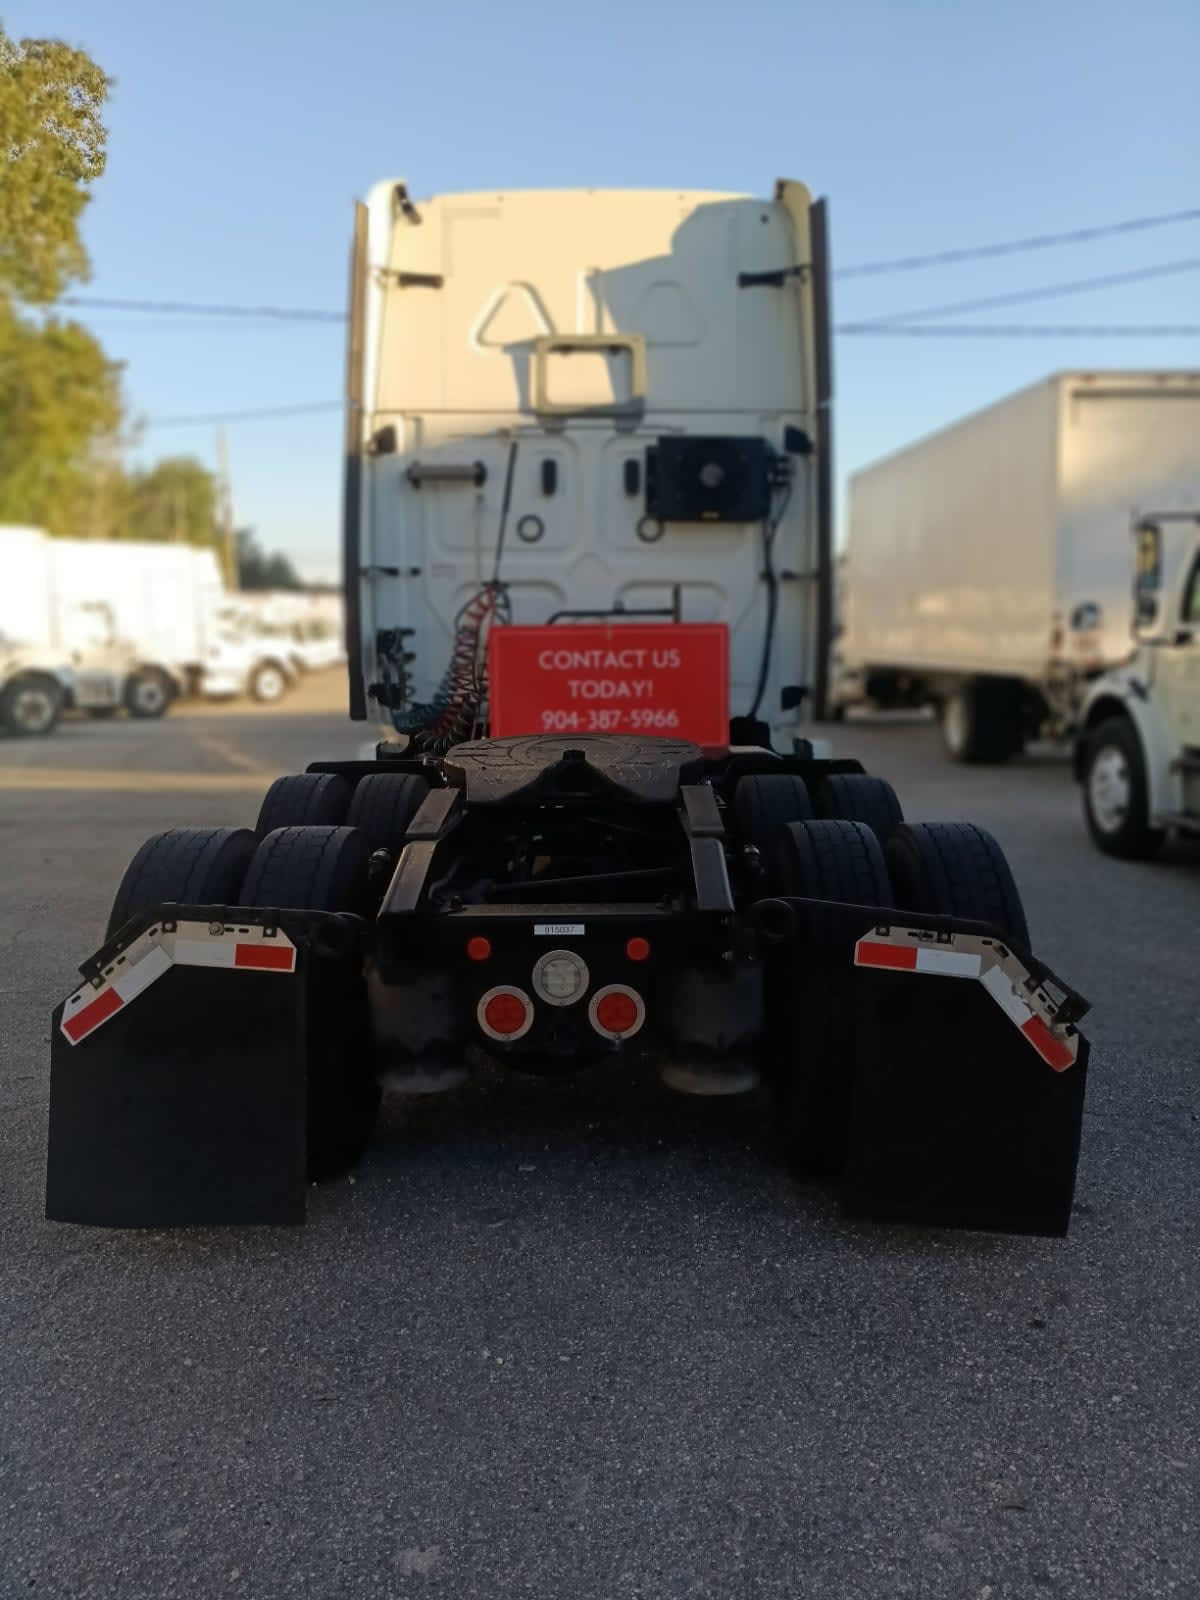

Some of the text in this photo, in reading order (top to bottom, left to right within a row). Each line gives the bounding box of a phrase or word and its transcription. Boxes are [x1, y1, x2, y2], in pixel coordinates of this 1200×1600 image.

[538, 650, 681, 669] CONTACT US
[569, 680, 653, 699] TODAY!
[541, 710, 679, 730] 904-387-5966
